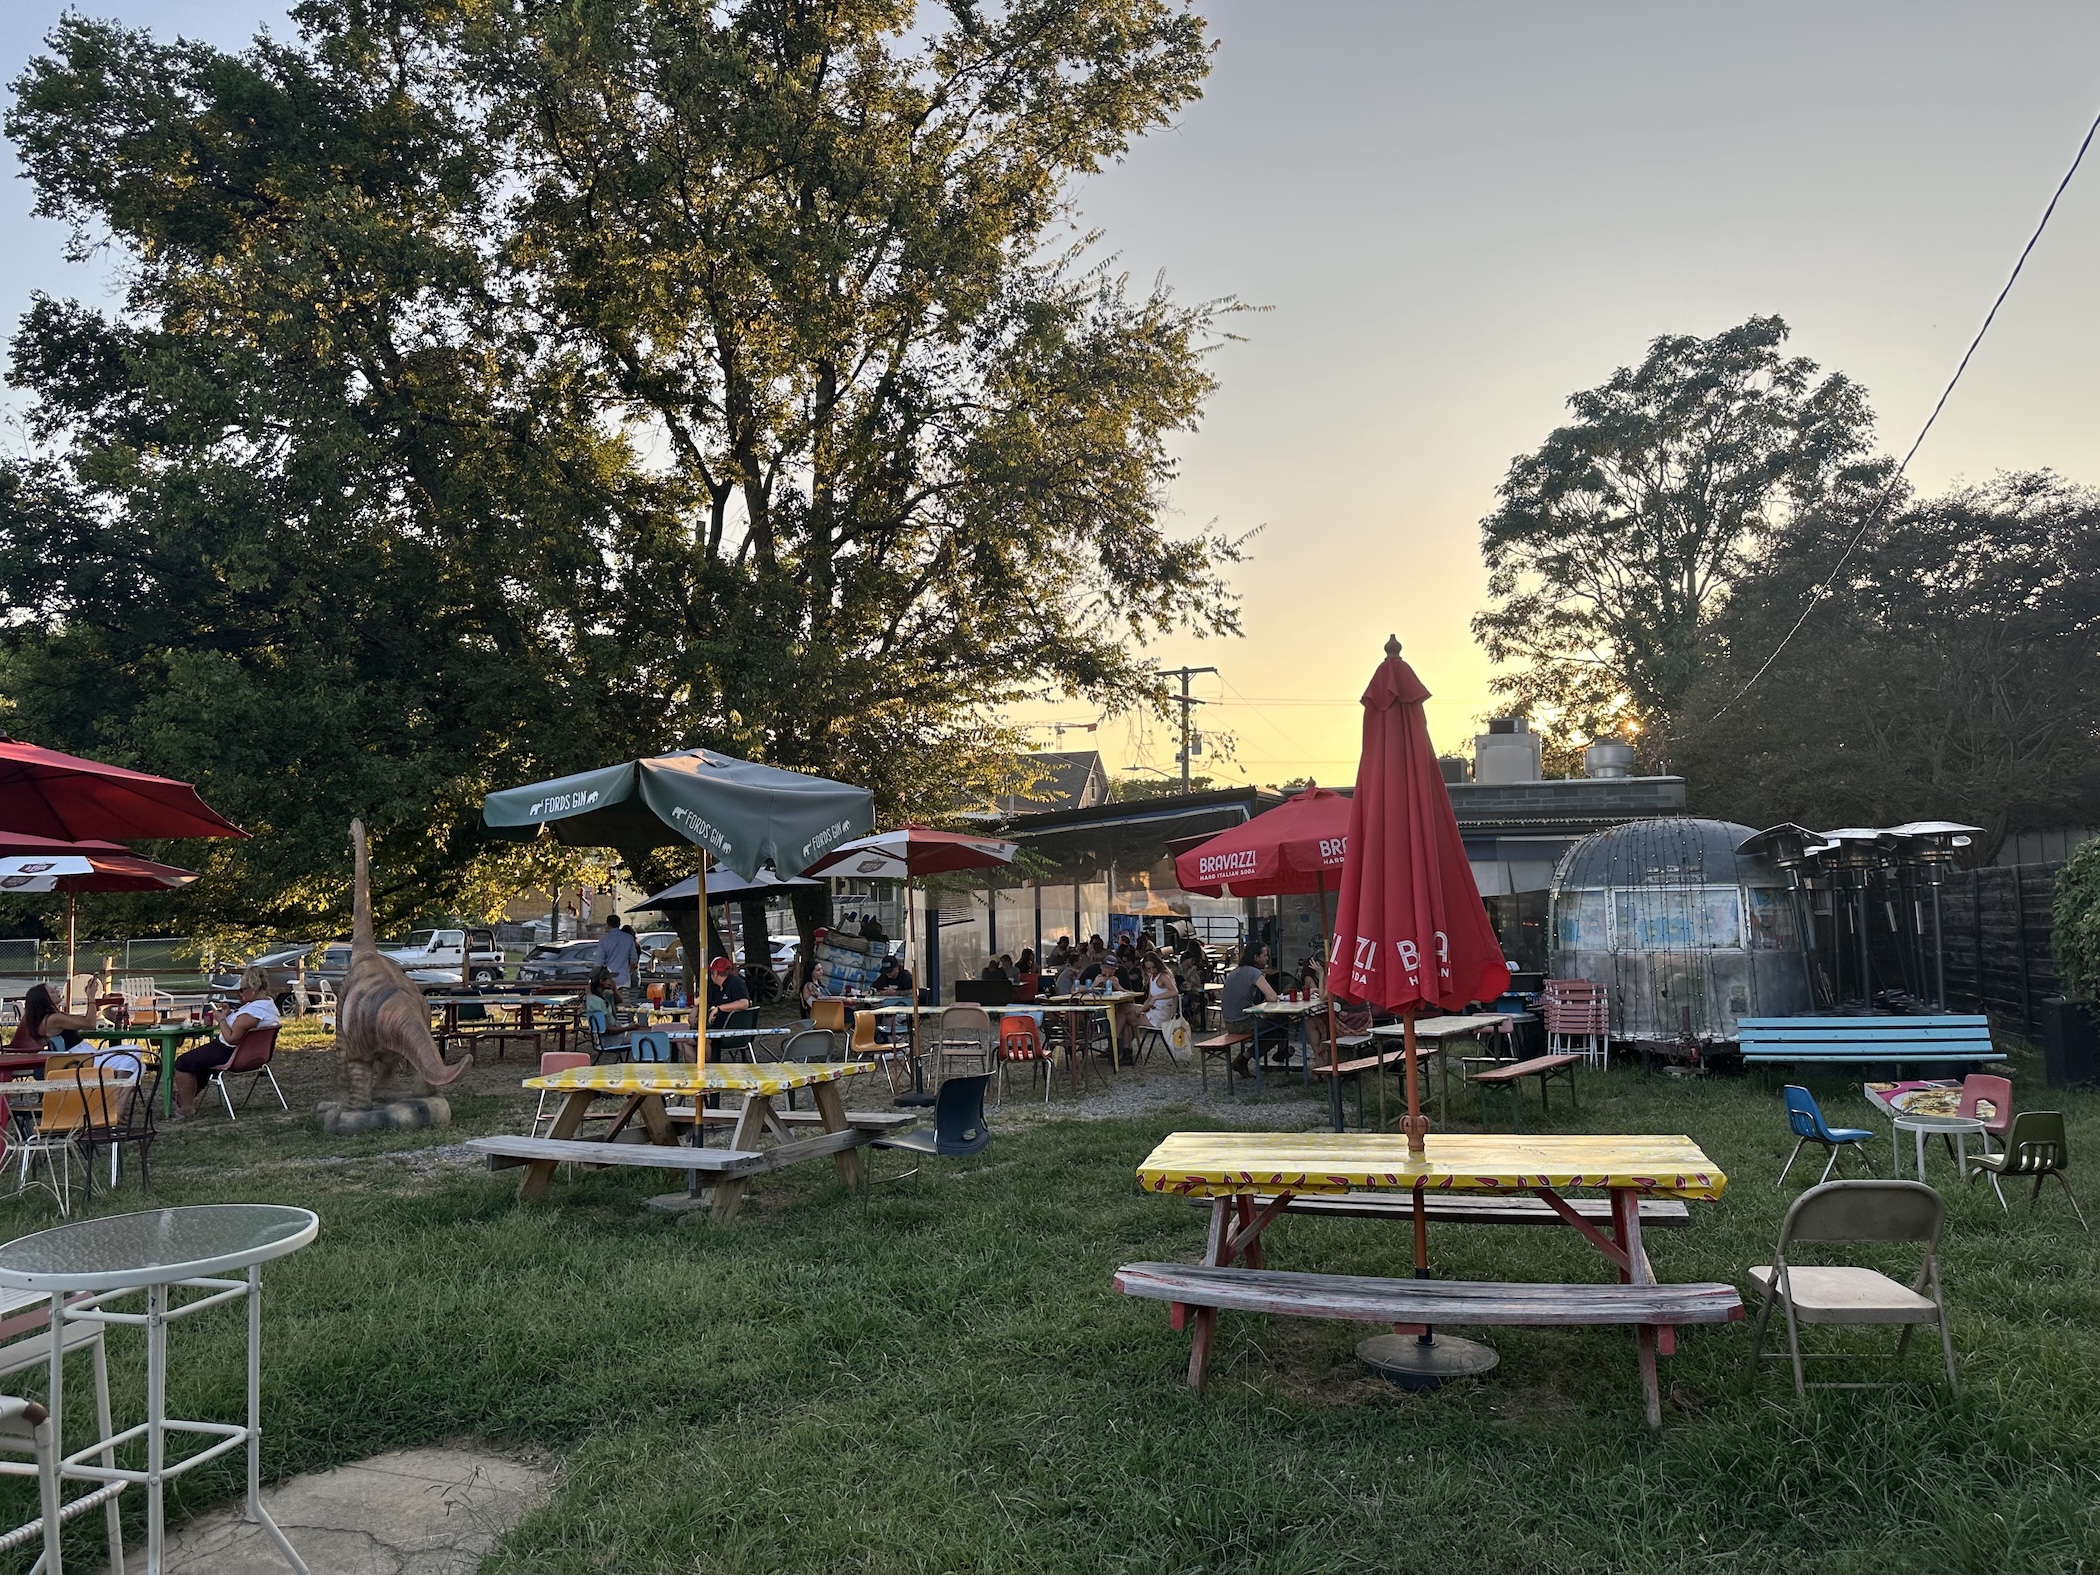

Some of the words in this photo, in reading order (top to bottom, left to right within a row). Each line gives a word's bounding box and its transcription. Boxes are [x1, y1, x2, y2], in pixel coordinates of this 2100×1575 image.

[544, 794, 570, 814] FORDS
[572, 790, 588, 808] GIN
[685, 811, 711, 839] FORDS
[710, 828, 725, 849] GIN
[812, 828, 832, 851] FORDS
[831, 820, 842, 839] GIN
[1199, 850, 1256, 874] BRAVAZZI
[1323, 856, 1345, 865] HARD
[1217, 870, 1239, 879] ITALIAN
